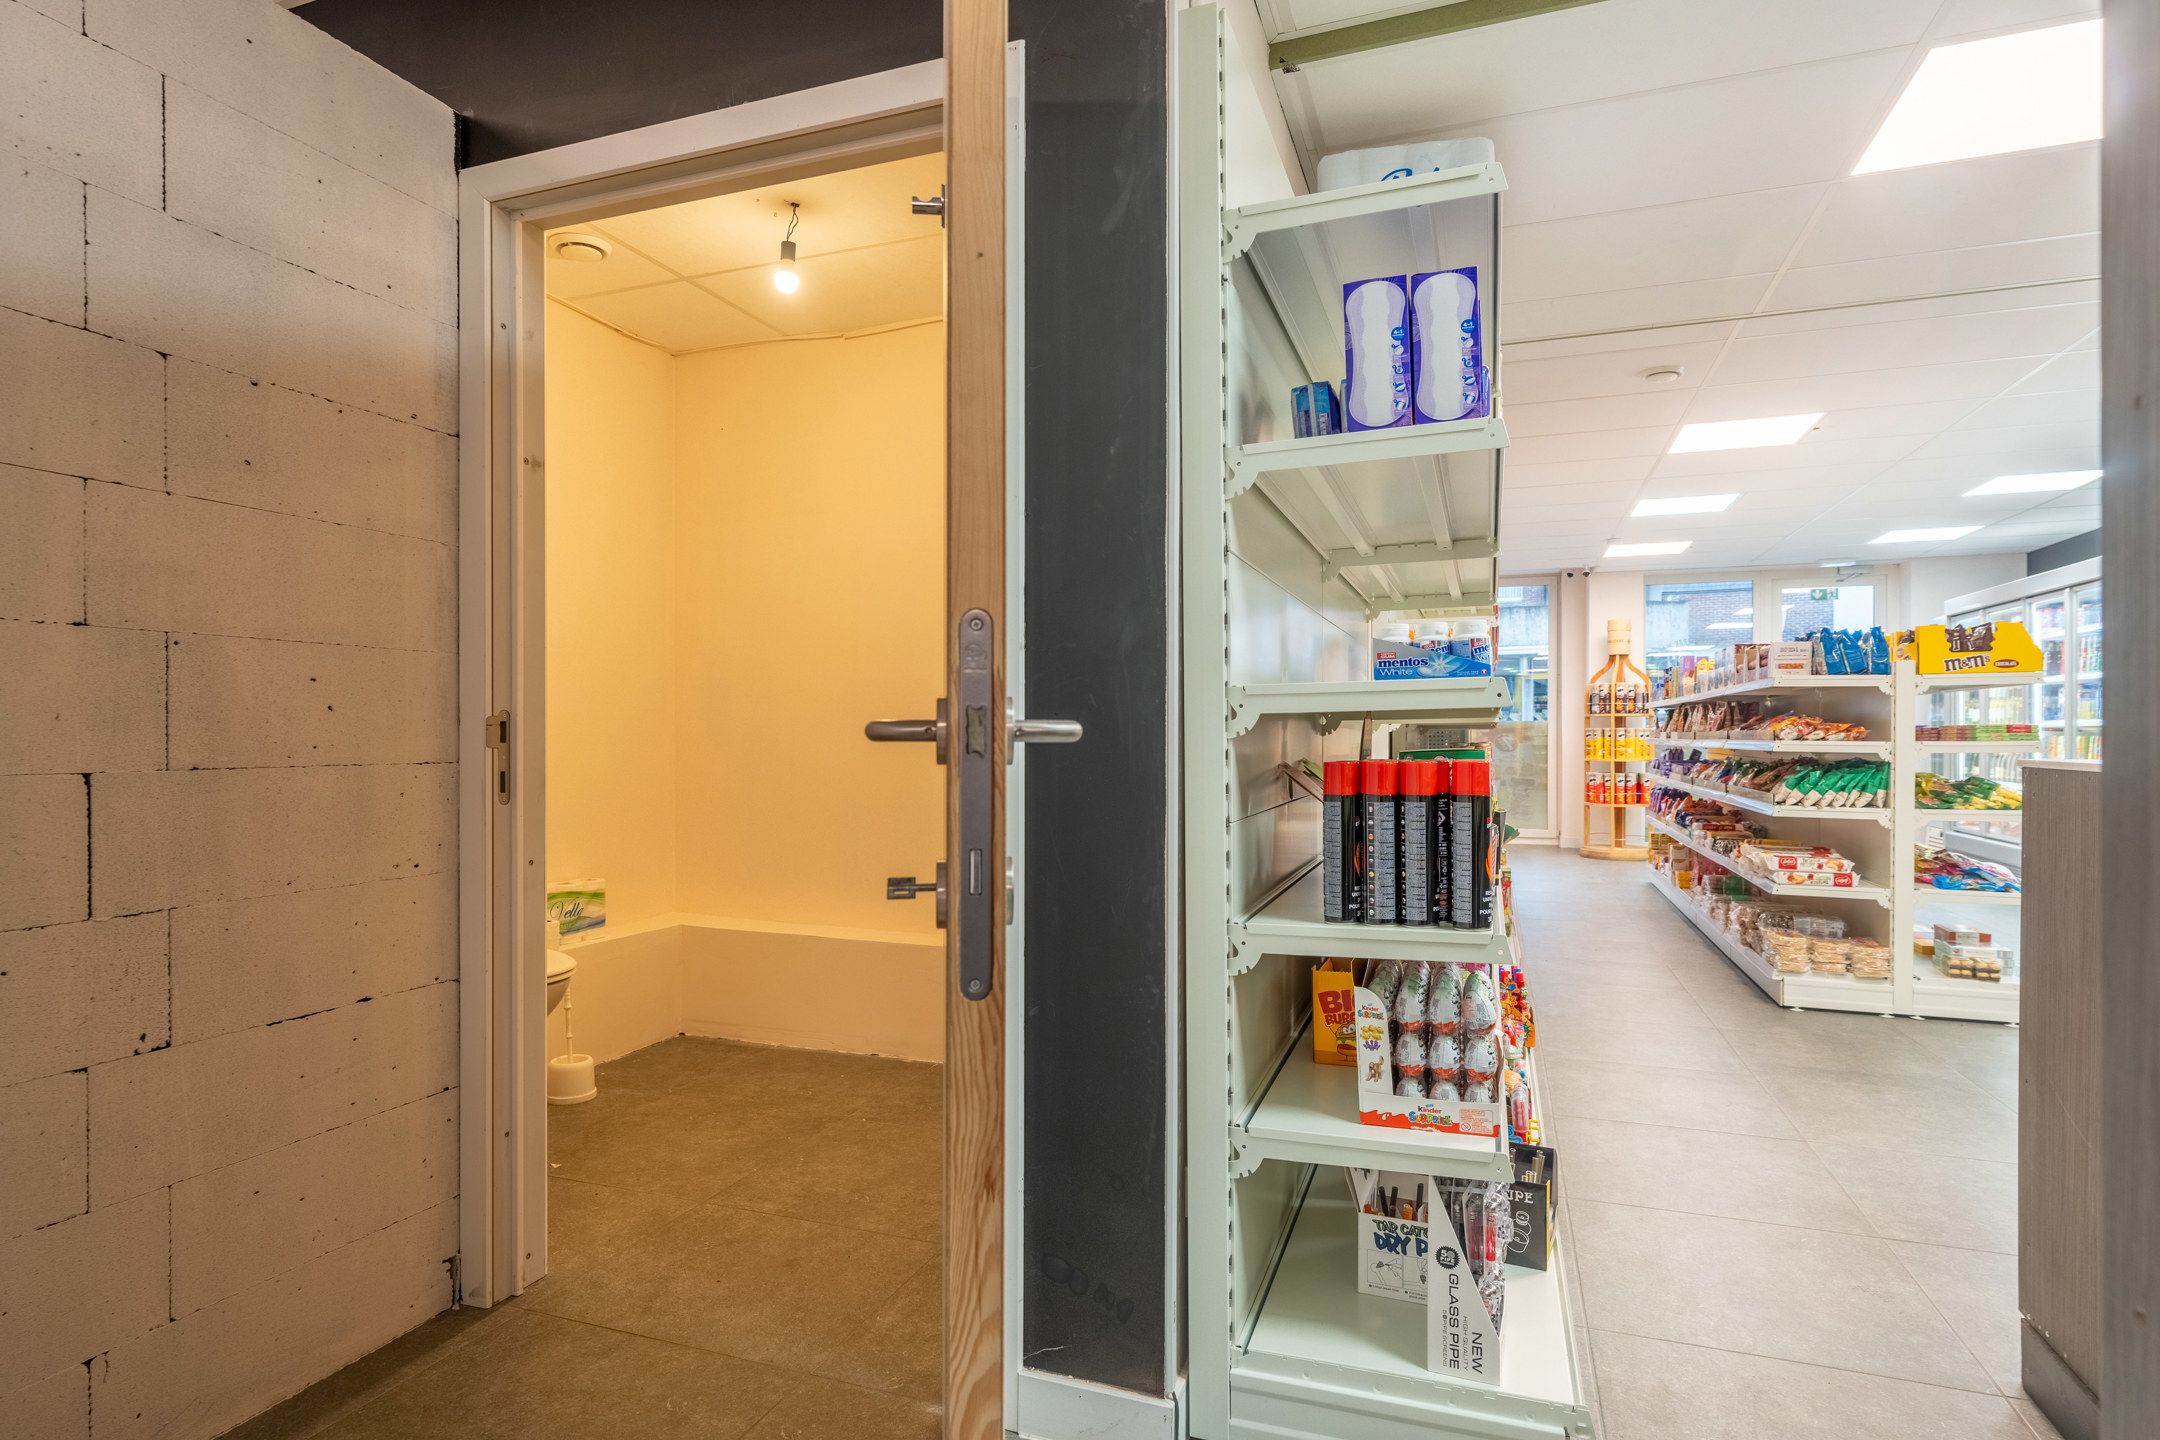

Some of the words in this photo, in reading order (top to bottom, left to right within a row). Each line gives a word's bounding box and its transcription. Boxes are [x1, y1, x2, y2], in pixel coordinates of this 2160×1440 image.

[1378, 657, 1429, 668] mentos
[1379, 667, 1412, 677] White
[1318, 989, 1355, 1014] BI
[1372, 1219, 1399, 1234] TAR
[1373, 1231, 1412, 1256] DRY
[1415, 1237, 1428, 1257] P
[1448, 1273, 1459, 1328] GLASS
[1449, 1332, 1460, 1370] PIPE
[1471, 1331, 1482, 1374] NEW
